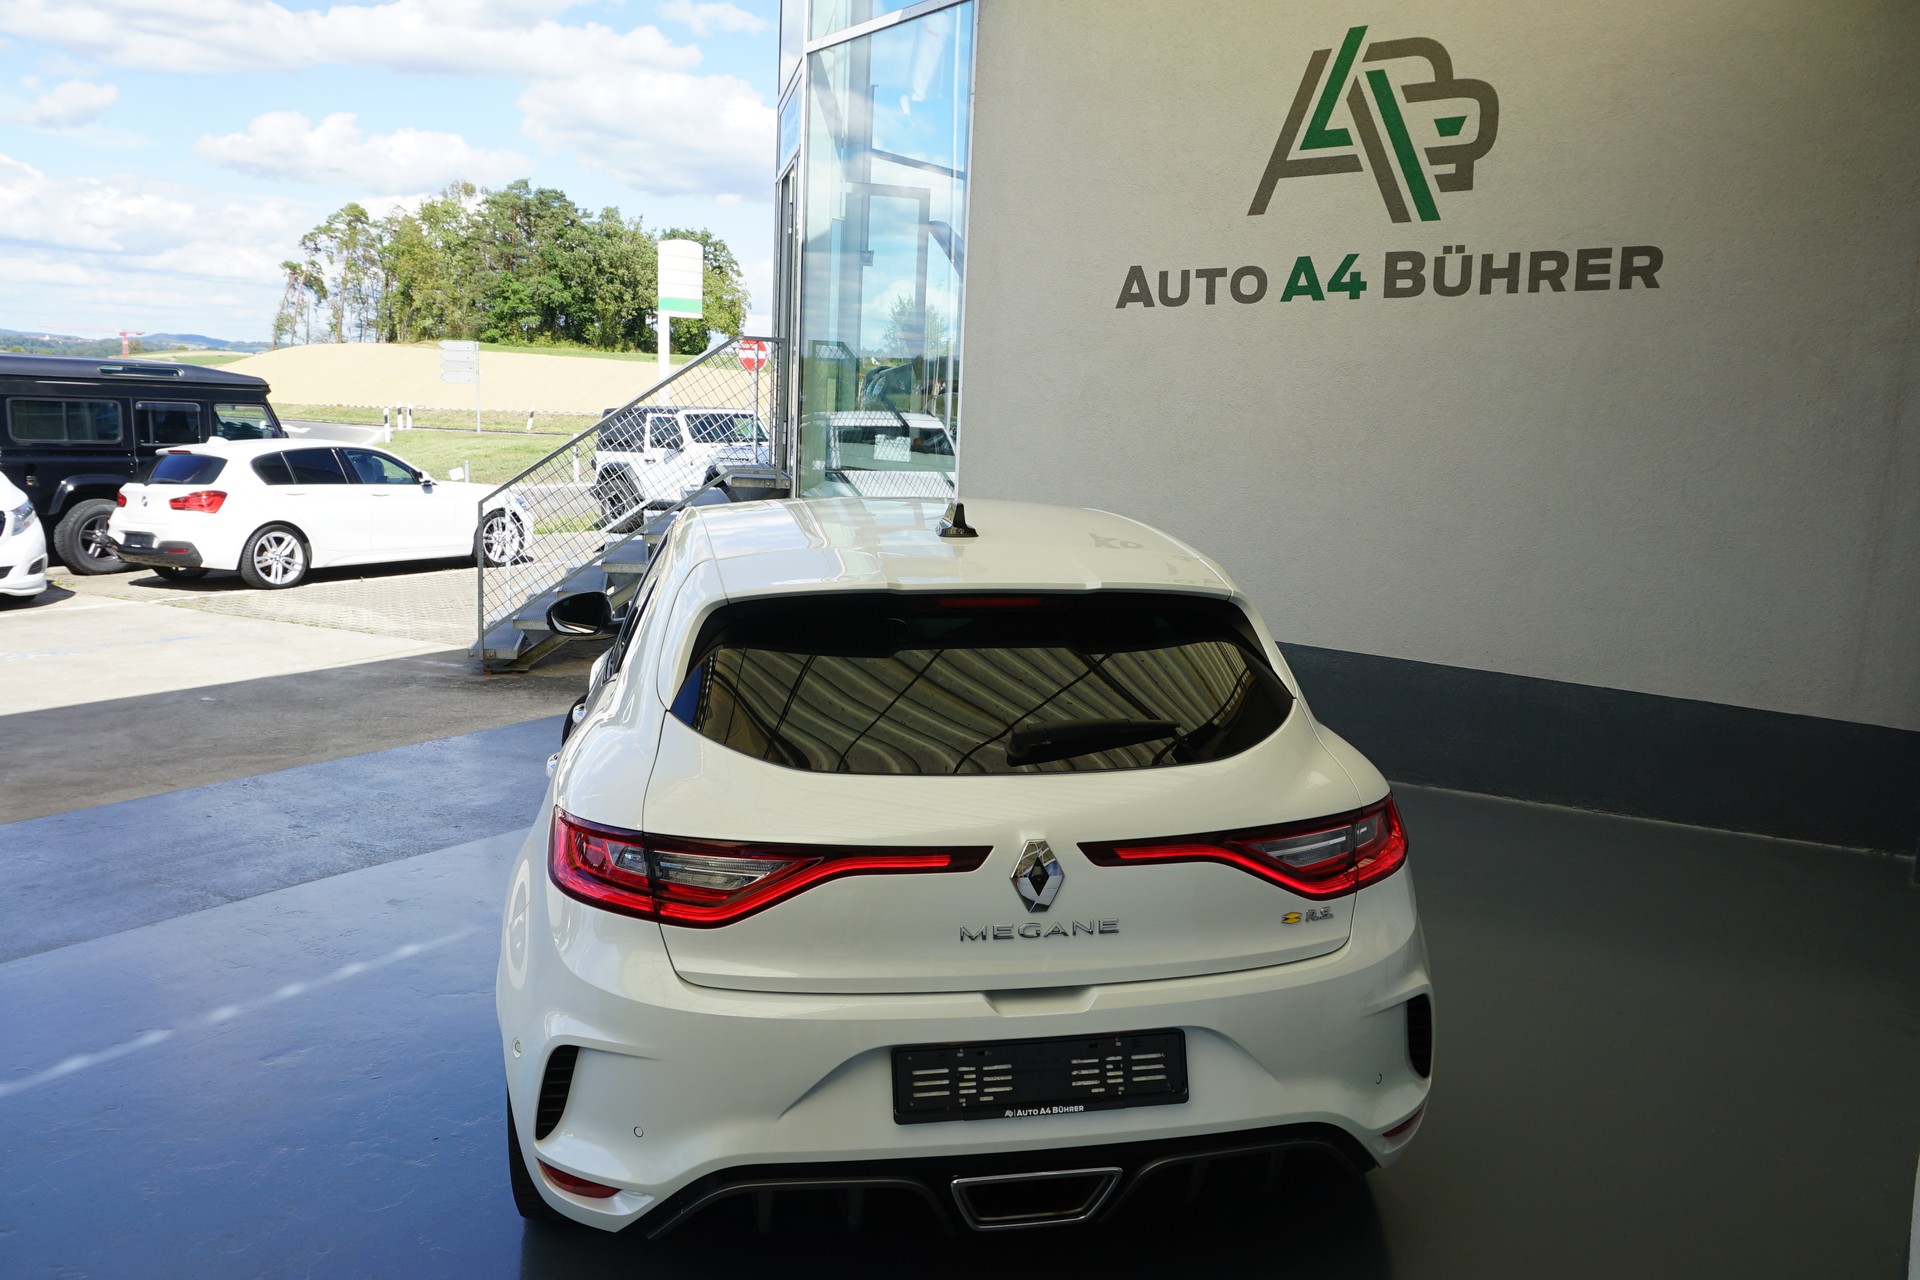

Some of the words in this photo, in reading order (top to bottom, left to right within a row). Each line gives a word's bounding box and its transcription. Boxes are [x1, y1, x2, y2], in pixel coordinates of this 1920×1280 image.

[1116, 264, 1268, 309] AUTO
[1280, 253, 1367, 302] A4
[1383, 244, 1664, 299] BÜHRER
[959, 917, 1119, 941] MEGANE
[1016, 1108, 1038, 1117] AUTO
[1040, 1107, 1051, 1115] A4
[1052, 1105, 1084, 1114] BÜHRER
